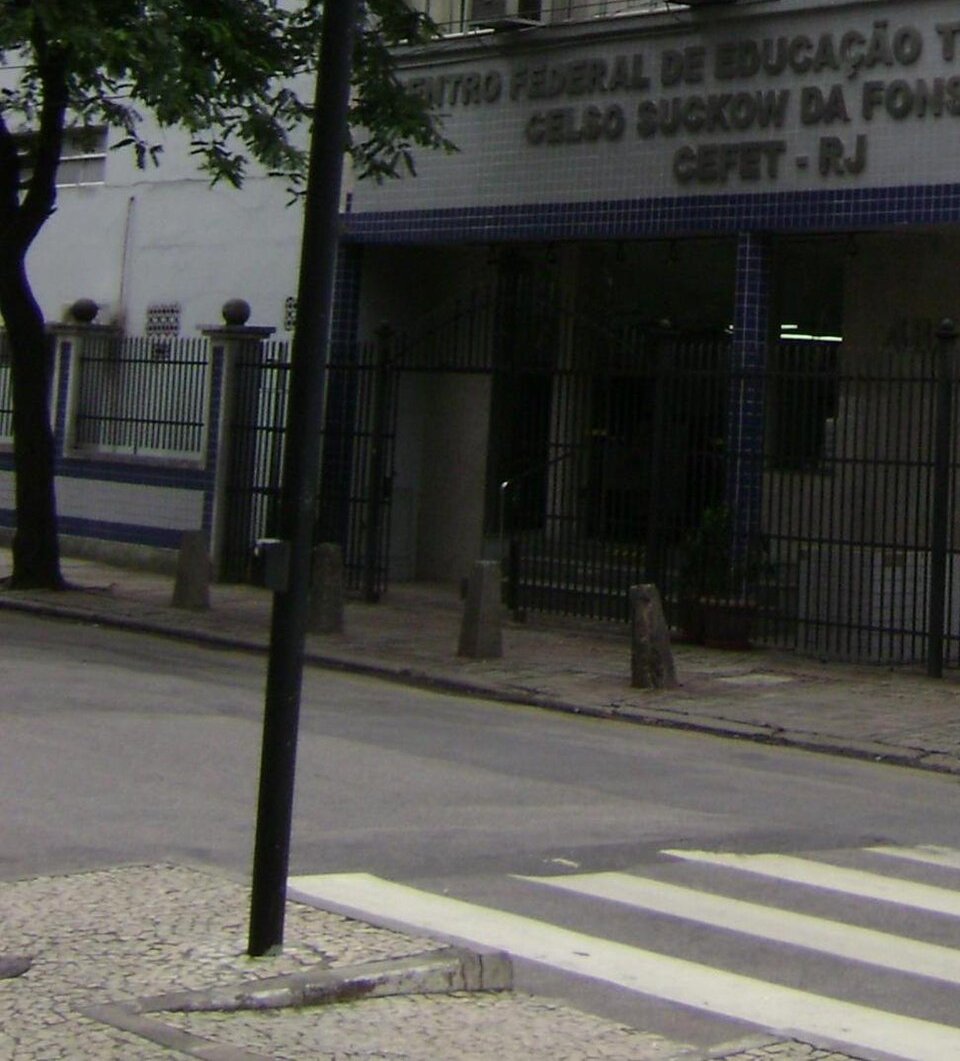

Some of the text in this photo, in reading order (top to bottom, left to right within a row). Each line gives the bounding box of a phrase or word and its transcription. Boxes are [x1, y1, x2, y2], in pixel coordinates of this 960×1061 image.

[397, 71, 502, 109] ENTRO
[510, 53, 650, 101] FEDERAL
[661, 46, 706, 87] DE
[715, 21, 923, 80] EDUCAÇÃO
[526, 103, 625, 145] CELSO
[637, 88, 791, 137] SUCKOW
[801, 84, 851, 125] DA
[673, 140, 787, 185] CEFET
[818, 135, 869, 176] RJ
